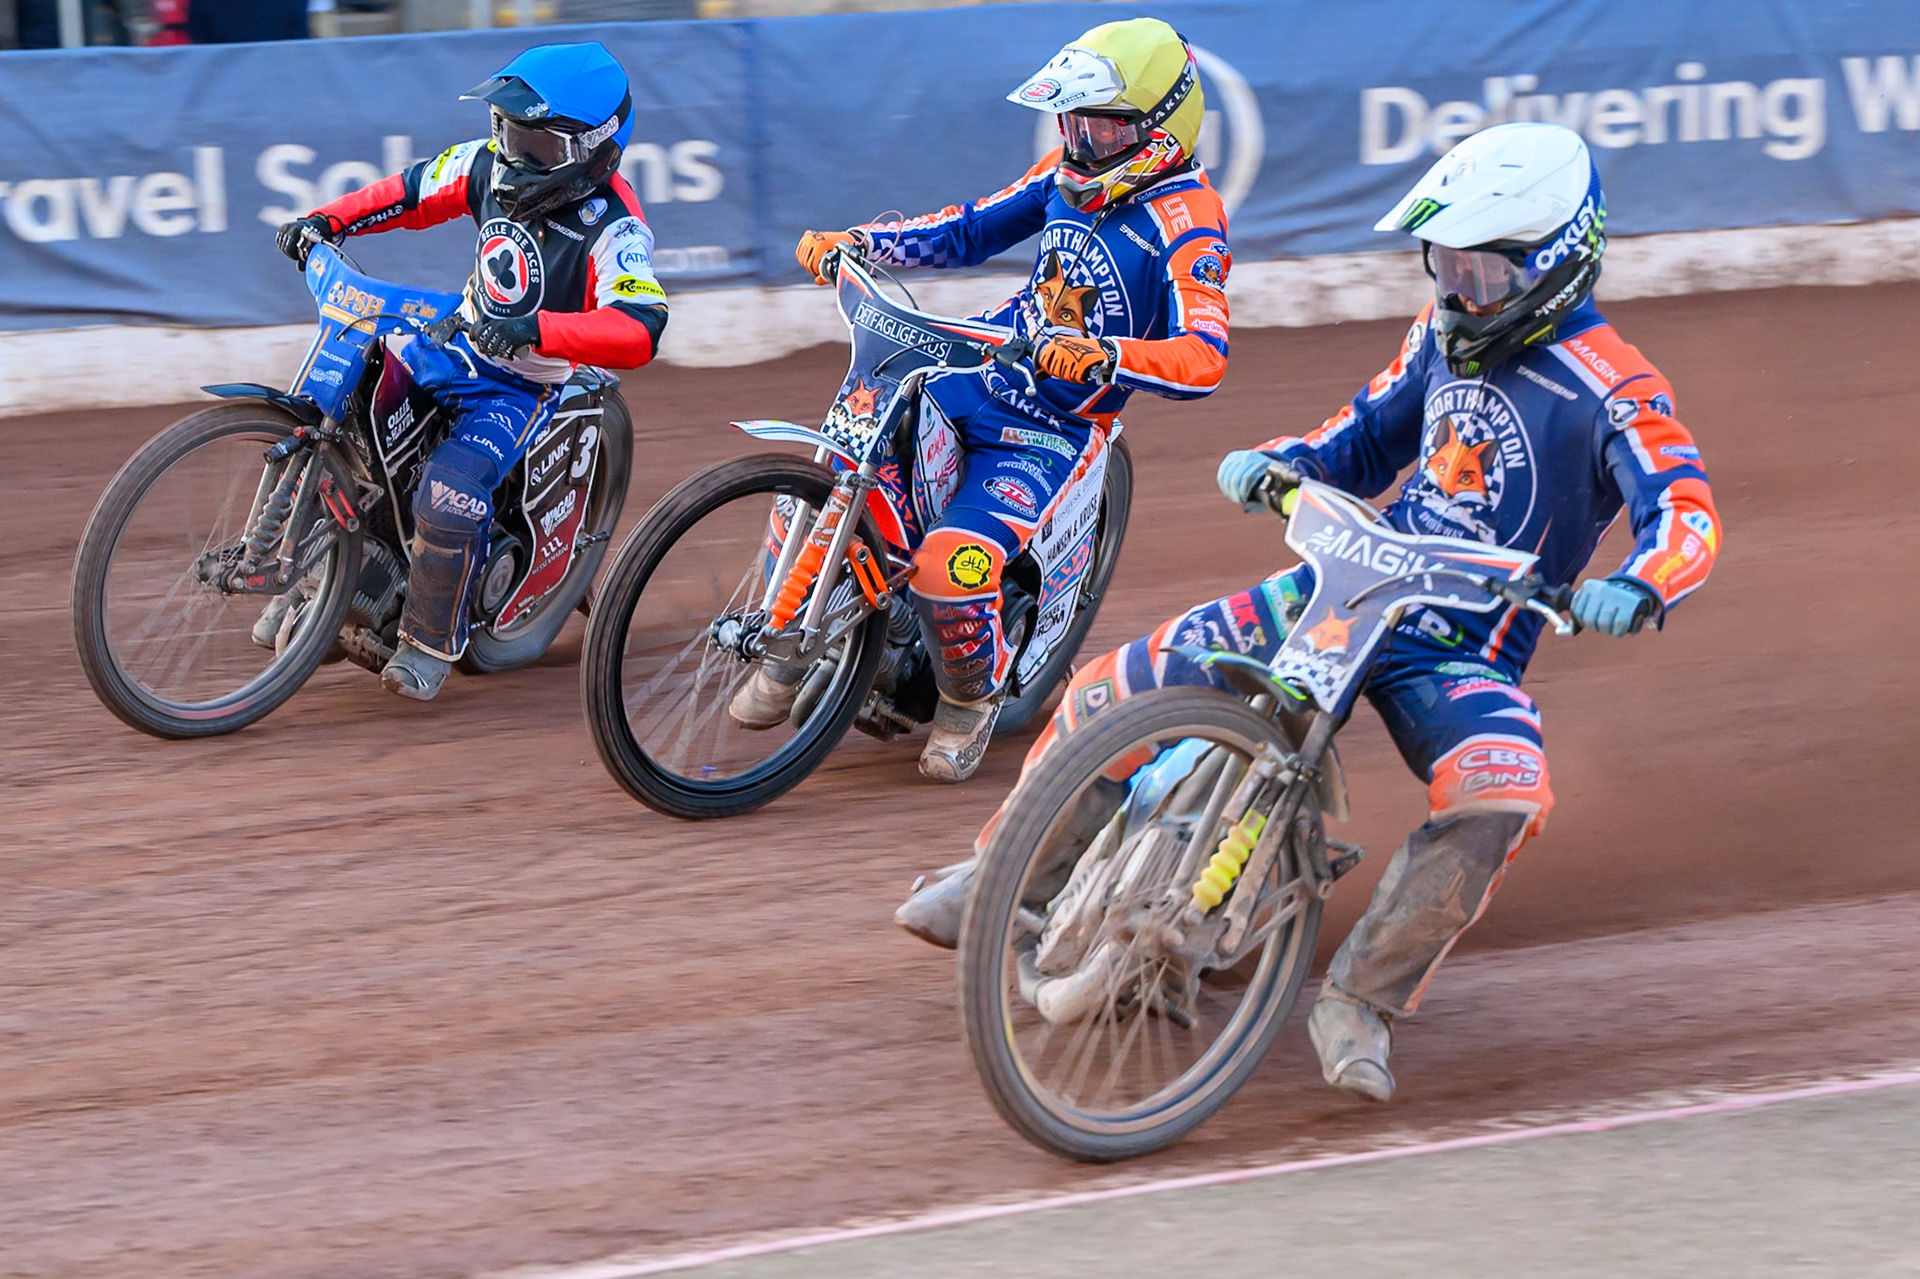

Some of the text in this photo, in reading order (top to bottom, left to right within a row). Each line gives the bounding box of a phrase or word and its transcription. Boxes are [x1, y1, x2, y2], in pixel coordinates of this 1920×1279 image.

[1141, 66, 1194, 129] OAKLEY
[1359, 62, 1826, 165] Delivering
[0, 146, 228, 243] avel
[482, 224, 540, 284] BELLE VUE ACES
[1535, 195, 1596, 270] OAKLEY
[1040, 228, 1124, 316] NORTHAMPTON
[343, 285, 386, 321] PSH
[856, 304, 948, 357] DET FAGLIGE HUS
[472, 435, 504, 460] LINK
[541, 436, 570, 475] LINK
[571, 425, 598, 478] 3
[1426, 389, 1526, 469] NORTHAMPTON
[995, 482, 1034, 506] STS
[1045, 524, 1072, 568] HANSEN
[1459, 750, 1540, 773] CBS
